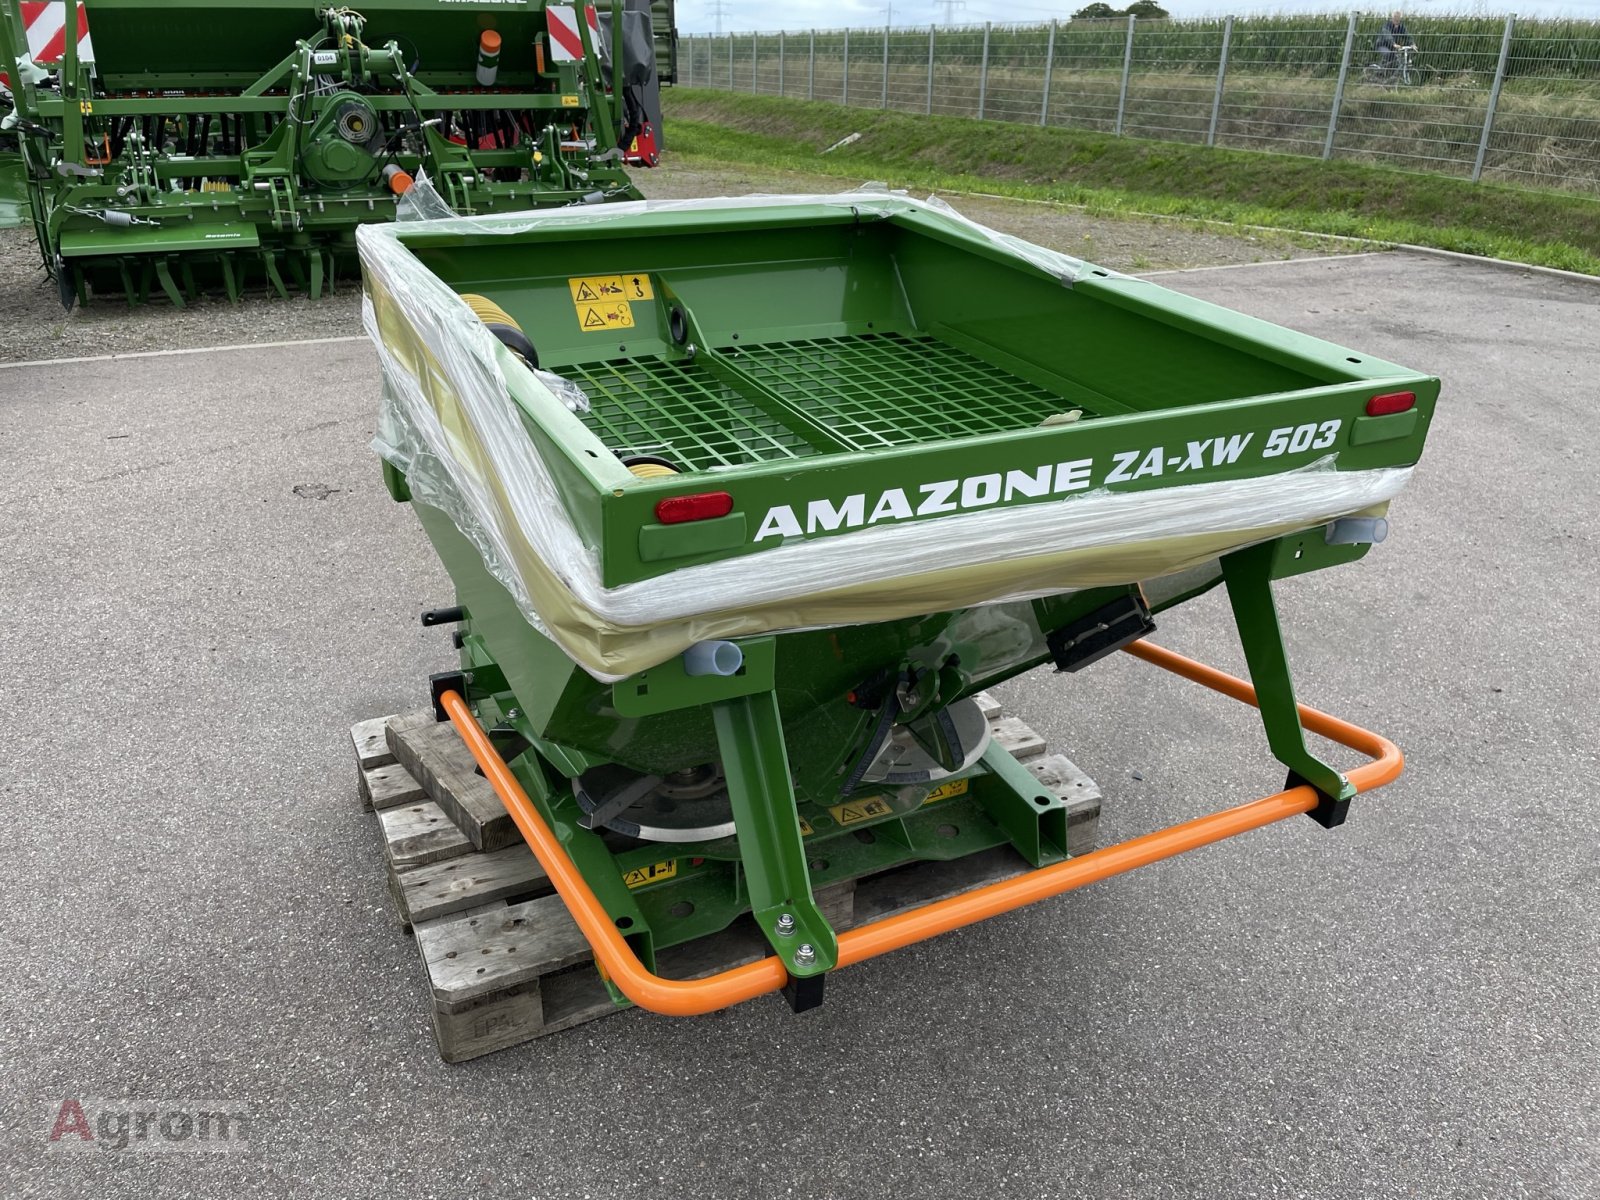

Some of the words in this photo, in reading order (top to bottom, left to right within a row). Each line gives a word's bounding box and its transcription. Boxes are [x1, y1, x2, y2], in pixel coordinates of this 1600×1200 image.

[753, 457, 1094, 543] AMAZONE
[1103, 432, 1255, 485] ZA-XW
[1262, 419, 1342, 458] 503
